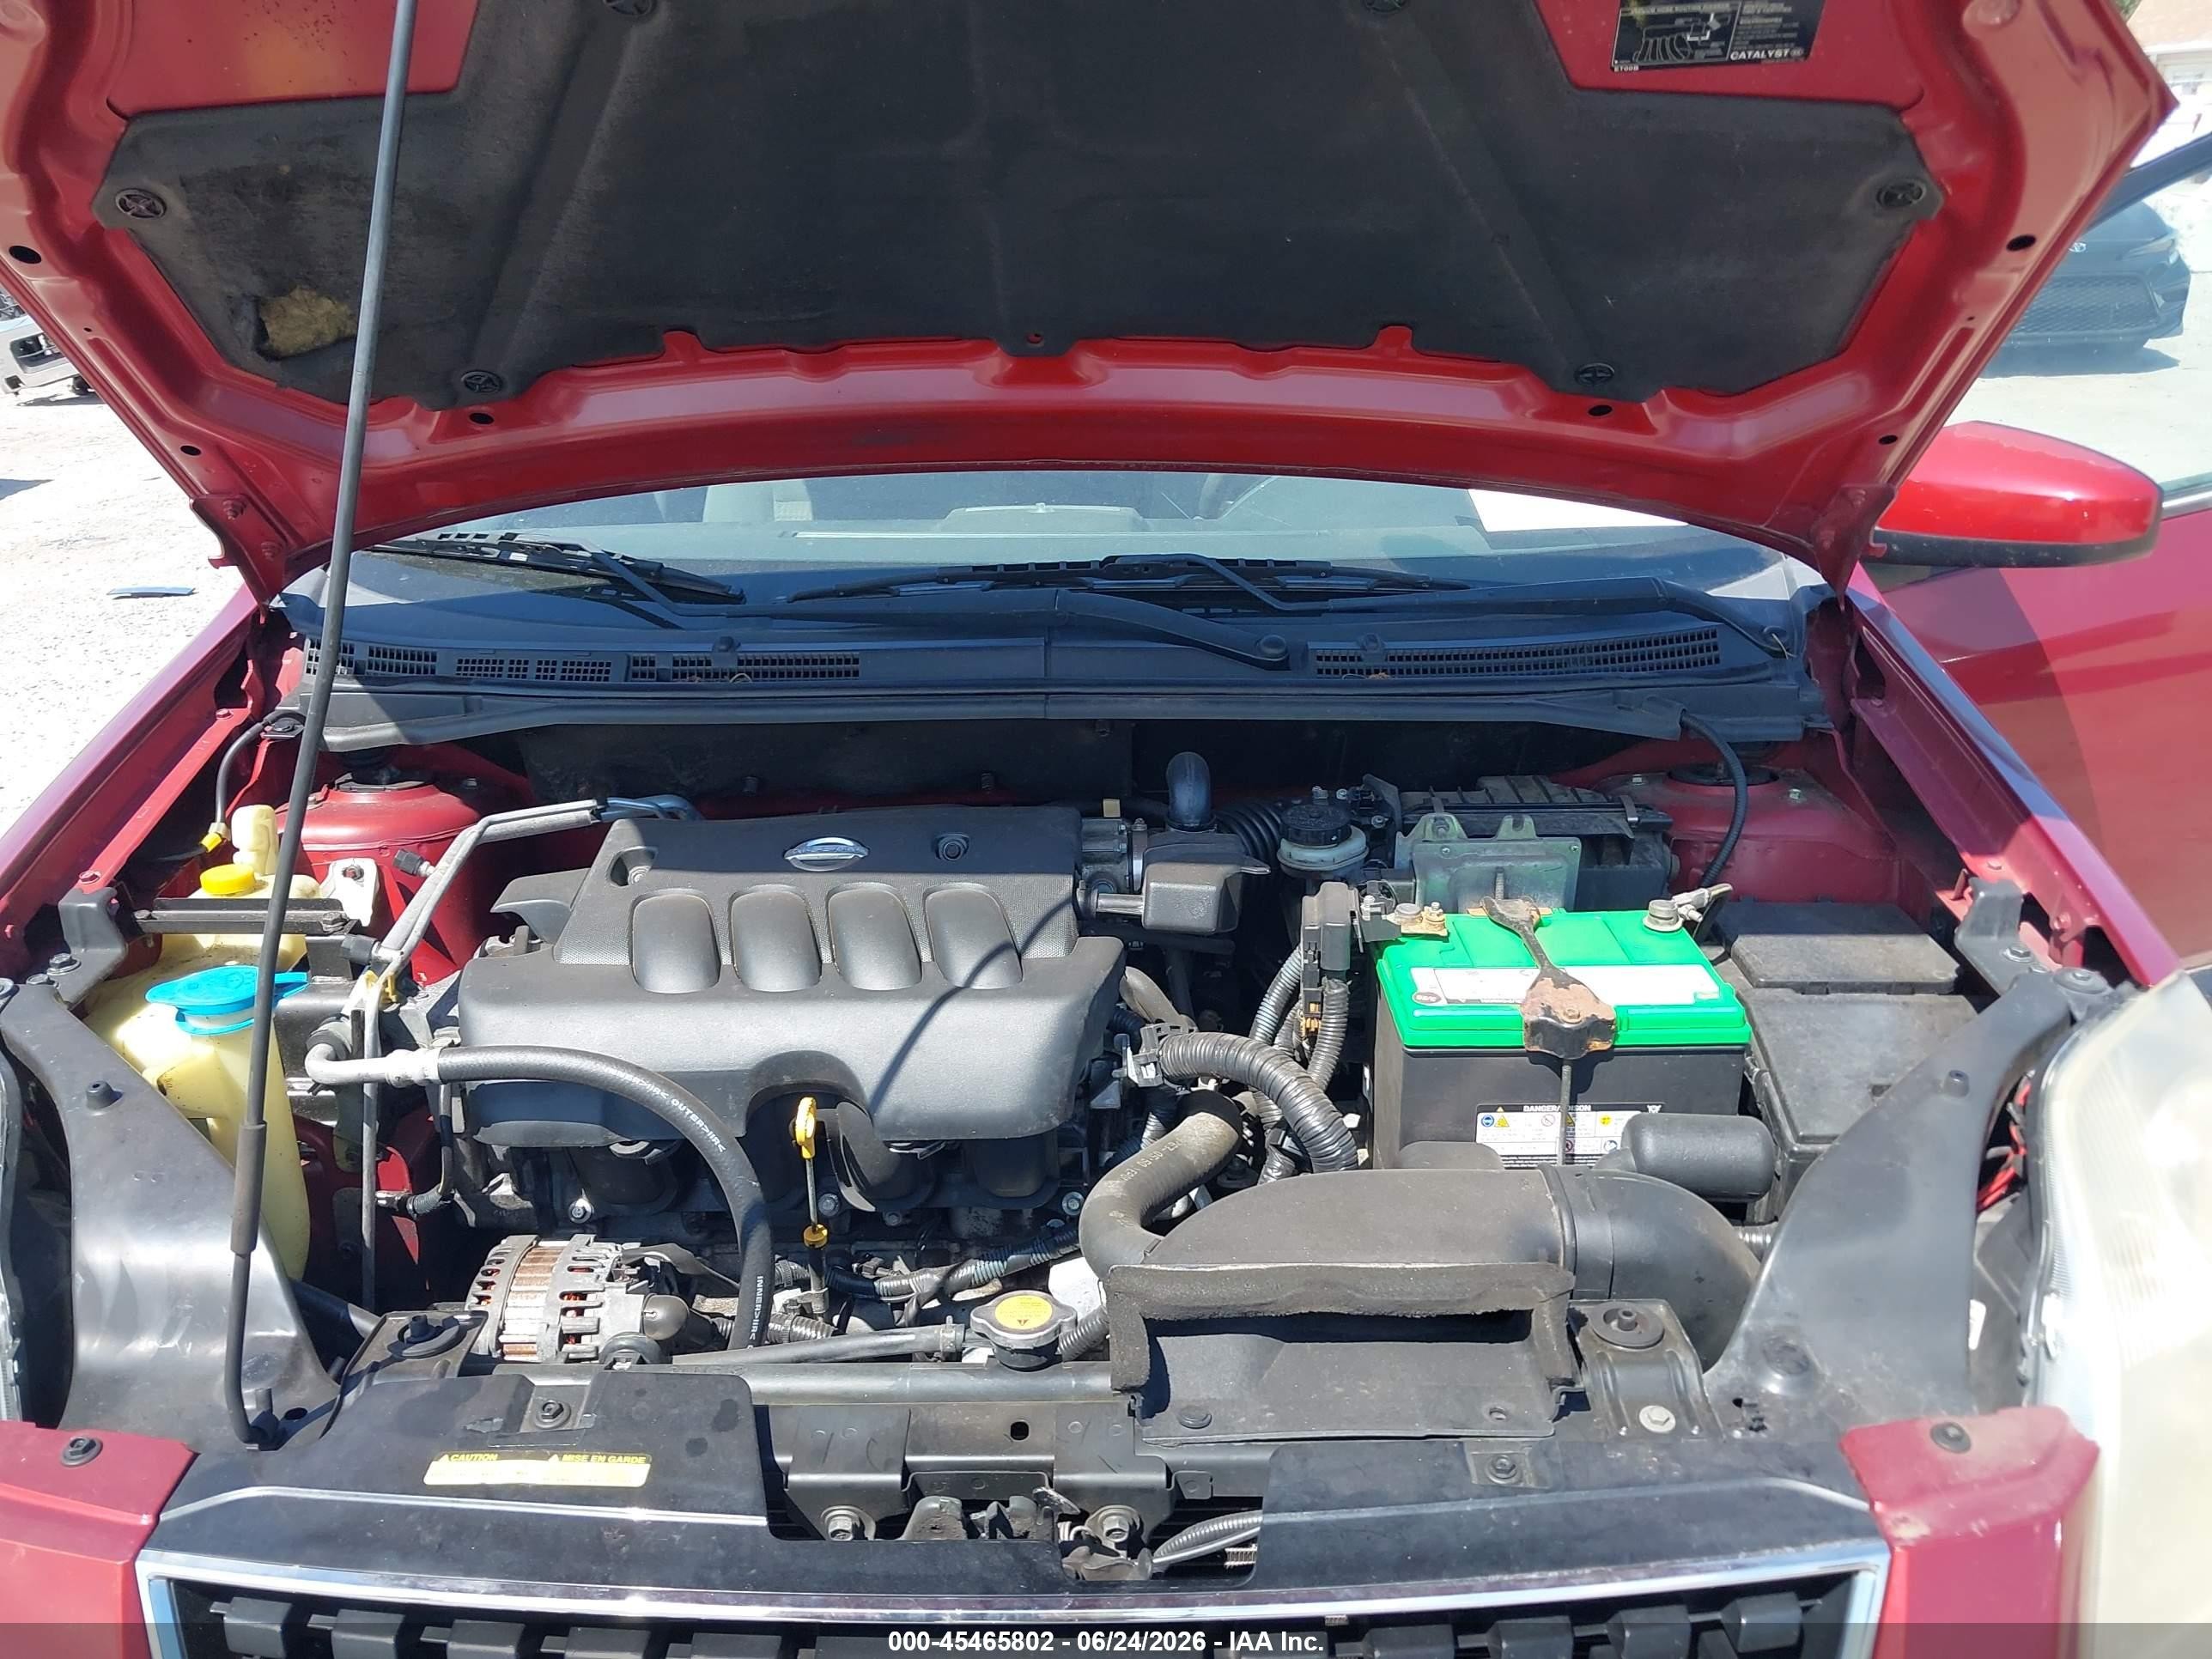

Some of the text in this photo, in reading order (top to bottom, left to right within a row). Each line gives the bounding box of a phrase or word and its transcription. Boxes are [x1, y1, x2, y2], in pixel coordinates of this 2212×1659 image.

[1729, 47, 1791, 61] CATALYST
[449, 1453, 499, 1462] CAUTION
[562, 1454, 647, 1464] MISE EN GARDE
